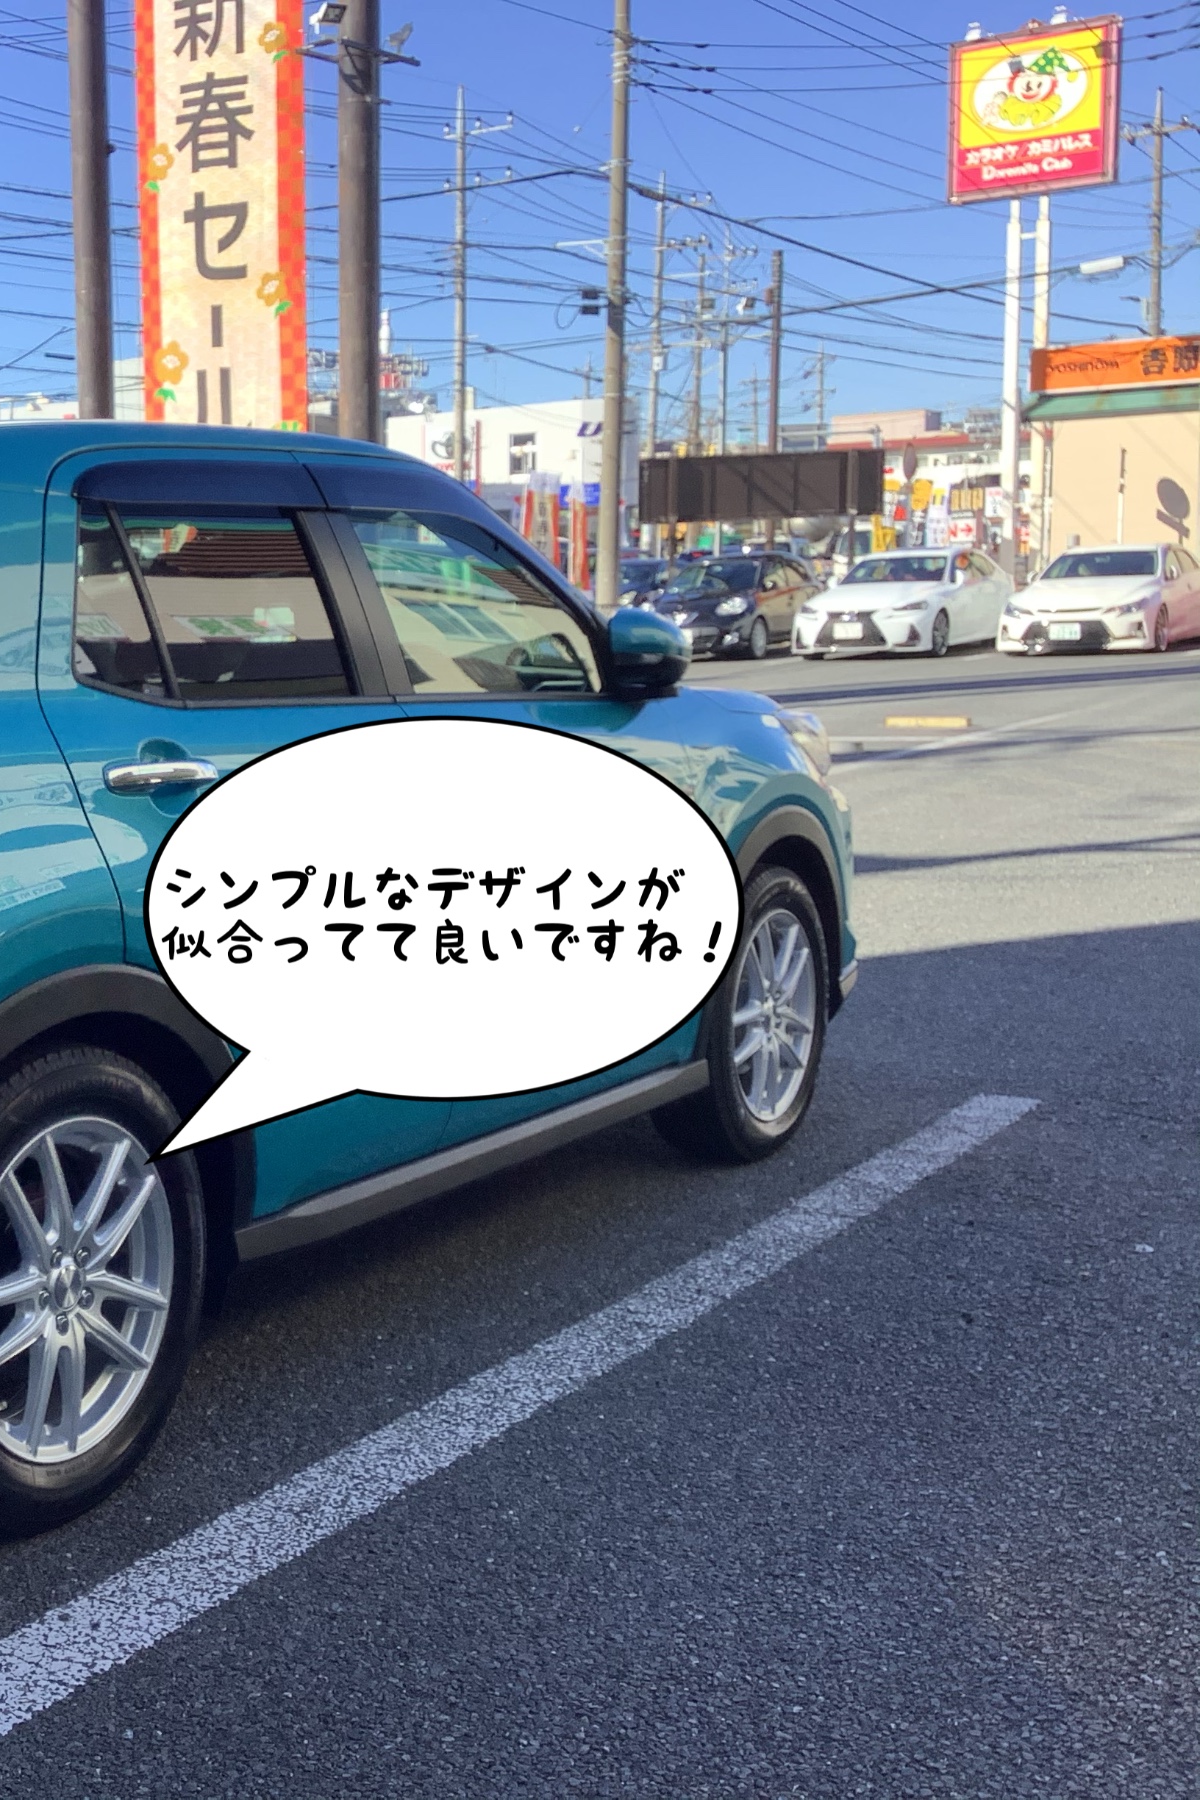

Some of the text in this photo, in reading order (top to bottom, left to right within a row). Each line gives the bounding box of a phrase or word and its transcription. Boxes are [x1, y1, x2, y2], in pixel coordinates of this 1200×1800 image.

[173, 0, 254, 426] 新春セール
